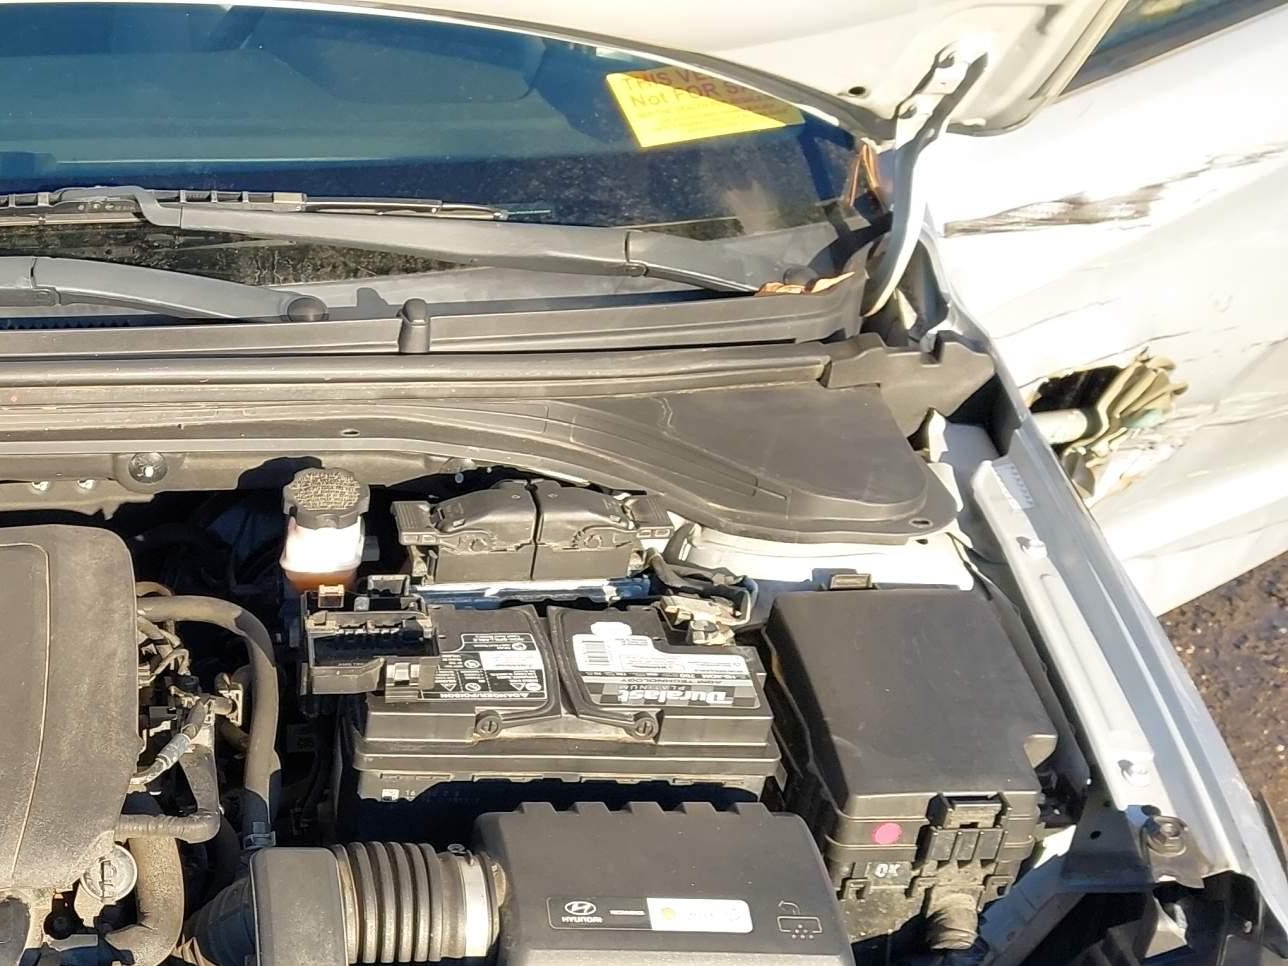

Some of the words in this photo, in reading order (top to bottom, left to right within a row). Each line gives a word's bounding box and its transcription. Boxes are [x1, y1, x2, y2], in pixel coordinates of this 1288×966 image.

[623, 71, 672, 90] THIS
[631, 93, 664, 107] Not
[674, 83, 720, 101] FOR
[616, 689, 733, 704] Duralast
[561, 916, 603, 924] HYUNDAI
